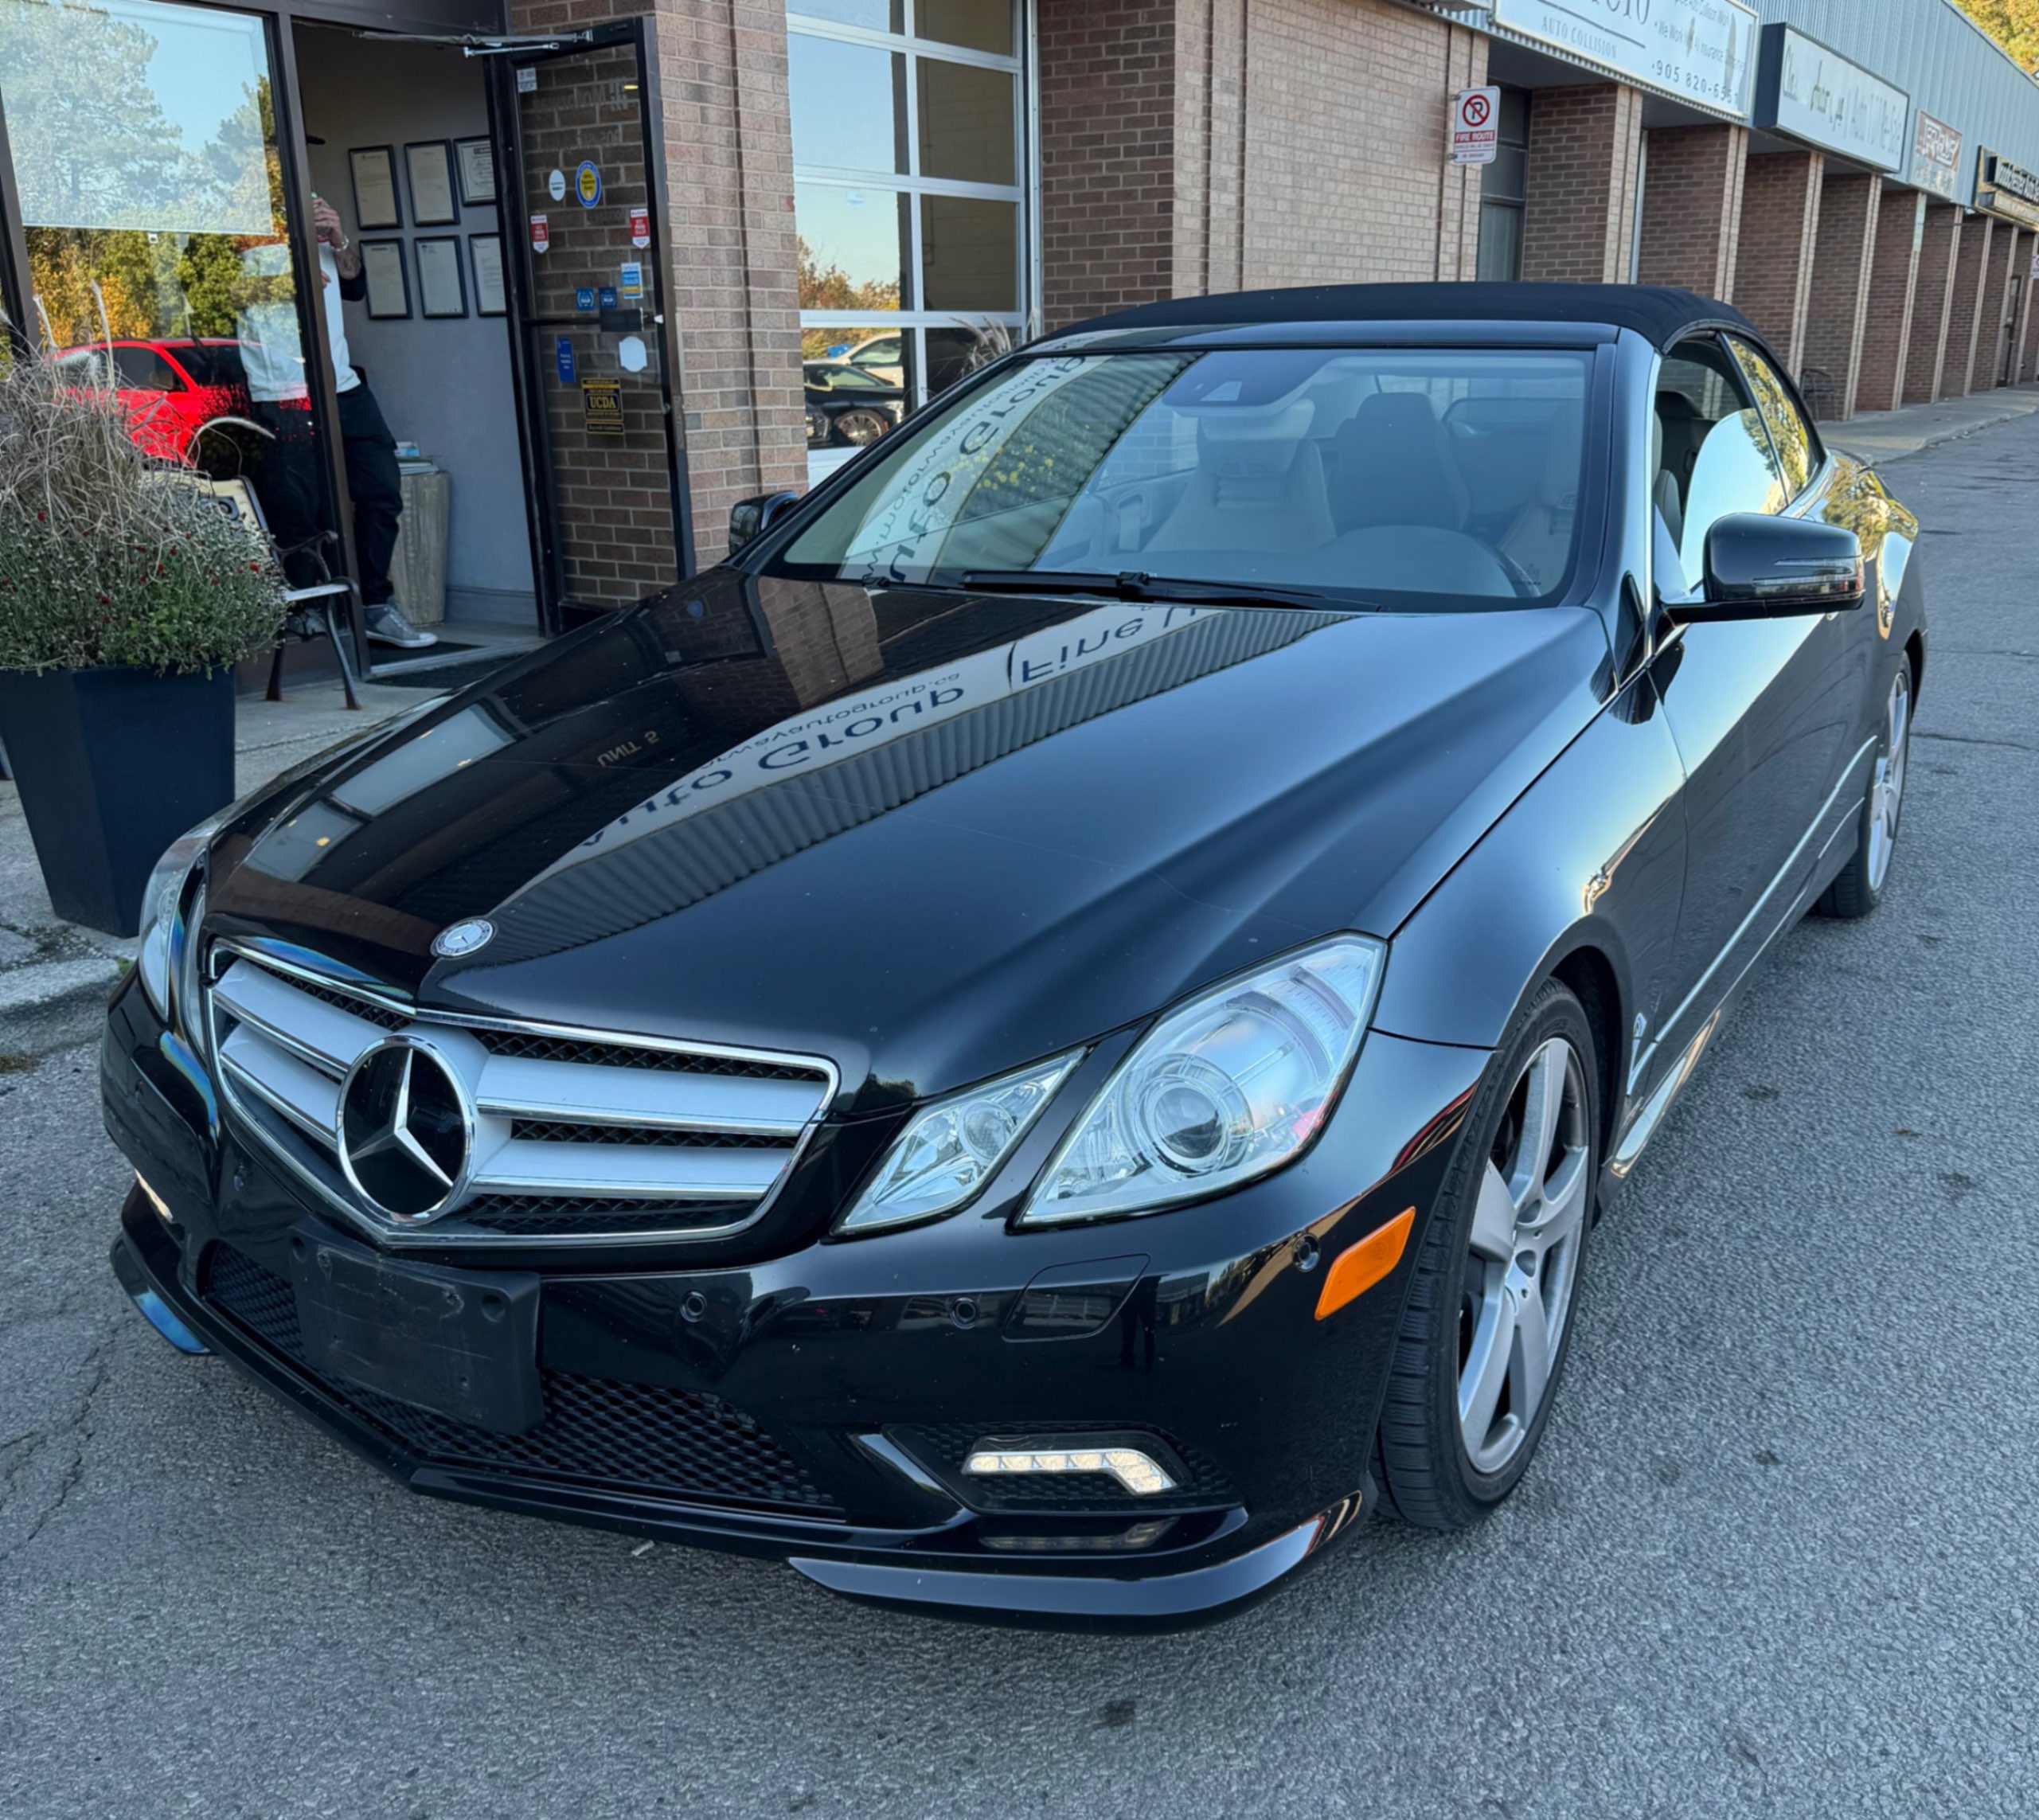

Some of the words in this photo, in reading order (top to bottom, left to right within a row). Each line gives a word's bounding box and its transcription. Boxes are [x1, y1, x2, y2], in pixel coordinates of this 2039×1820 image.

[1542, 15, 1568, 39] AUTO
[1571, 27, 1618, 59] COLLISION
[1656, 60, 1680, 83] 905
[1456, 133, 1471, 142] FIRE
[1472, 131, 1494, 141] ROUTE
[589, 396, 616, 408] UCDA
